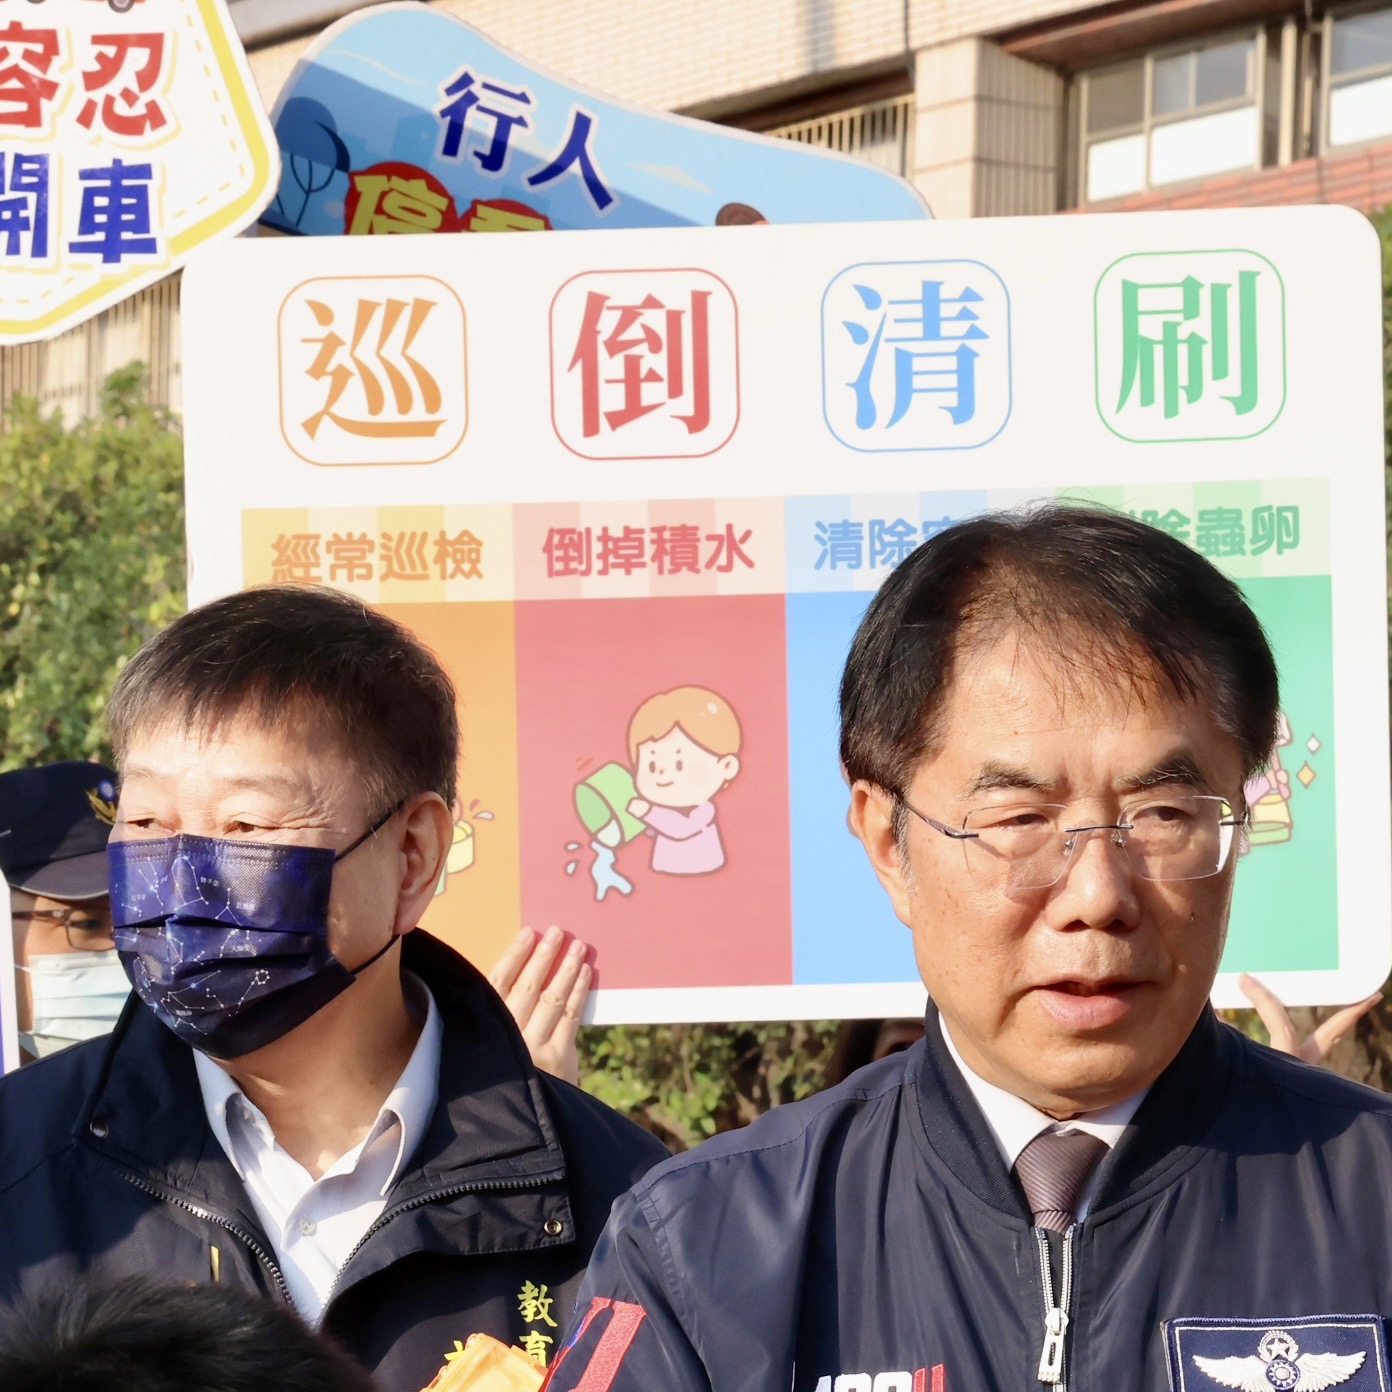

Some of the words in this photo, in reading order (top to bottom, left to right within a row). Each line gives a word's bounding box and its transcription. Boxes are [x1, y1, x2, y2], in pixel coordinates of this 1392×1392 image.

[439, 70, 614, 212] 行人
[350, 175, 550, 235] 停
[300, 298, 449, 440] 巡
[566, 290, 714, 437] 倒
[841, 281, 992, 431] 清
[1115, 270, 1262, 421] 刷
[270, 529, 484, 583] 經常巡檢
[542, 523, 755, 578] 倒掉積水
[1128, 505, 1300, 558] 除蟲卵
